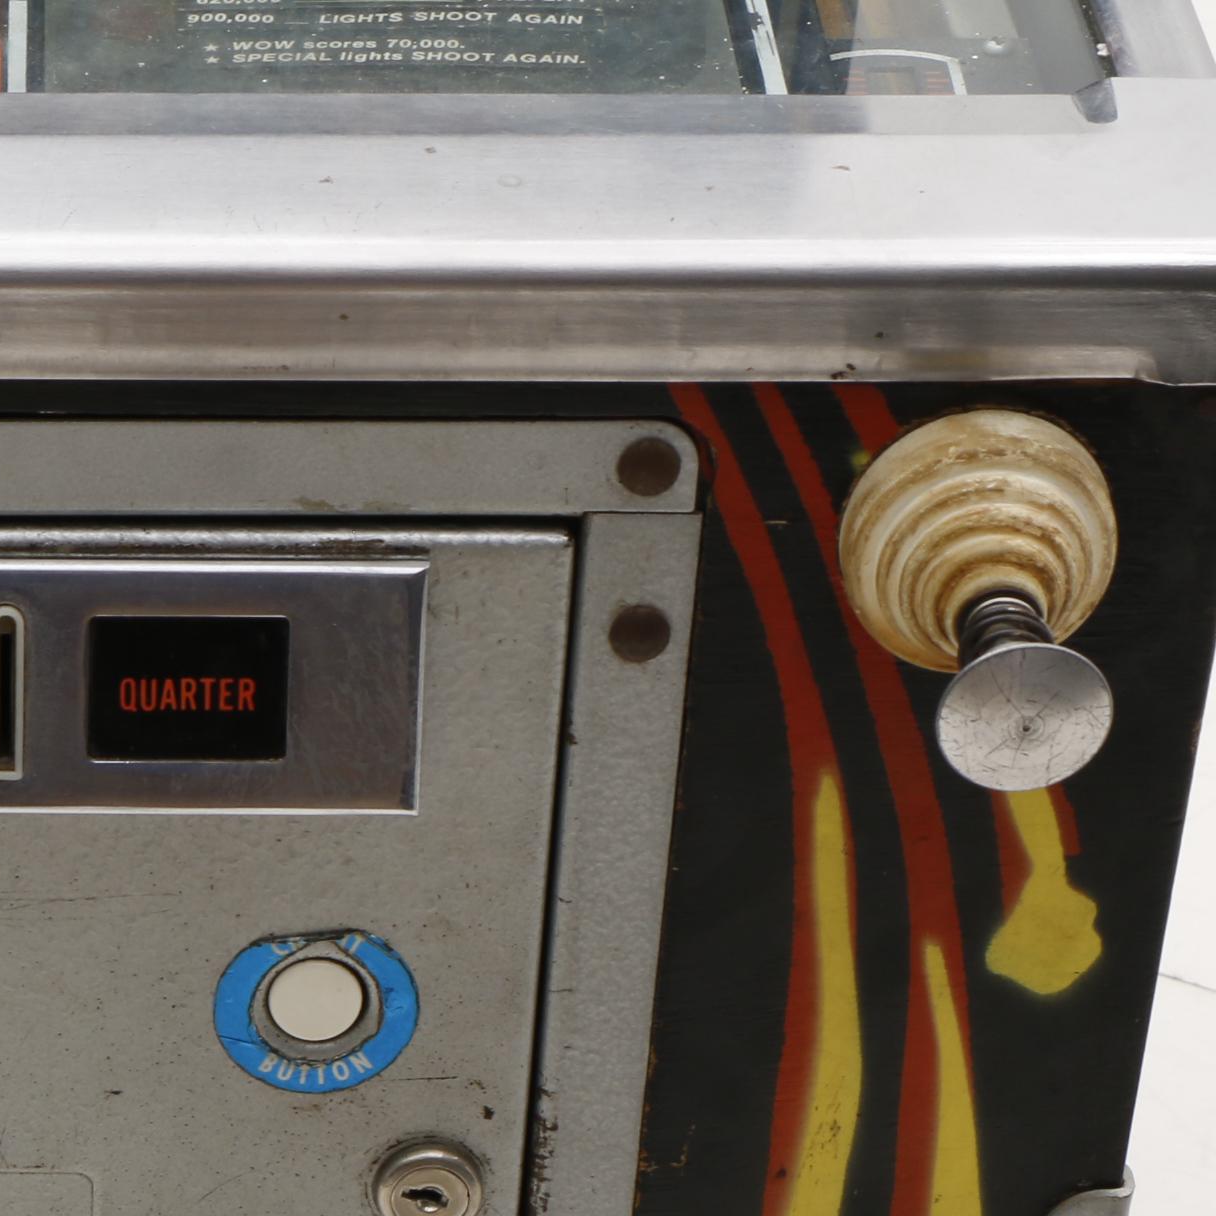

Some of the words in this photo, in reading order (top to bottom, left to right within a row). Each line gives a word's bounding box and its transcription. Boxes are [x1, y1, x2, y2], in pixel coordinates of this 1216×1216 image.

[187, 12, 274, 24] 900,000
[319, 12, 403, 24] LIGHTS
[413, 11, 497, 23] SHOOT
[507, 13, 583, 25] AGAIN
[232, 41, 295, 51] WOW
[302, 40, 377, 49] scores
[231, 52, 333, 64] SPECIAL
[339, 51, 403, 63] lights
[411, 51, 496, 62] SHOOT
[504, 53, 587, 64] AGAIN.
[119, 678, 257, 711] QUARTER
[257, 1051, 374, 1085] BUTTON
